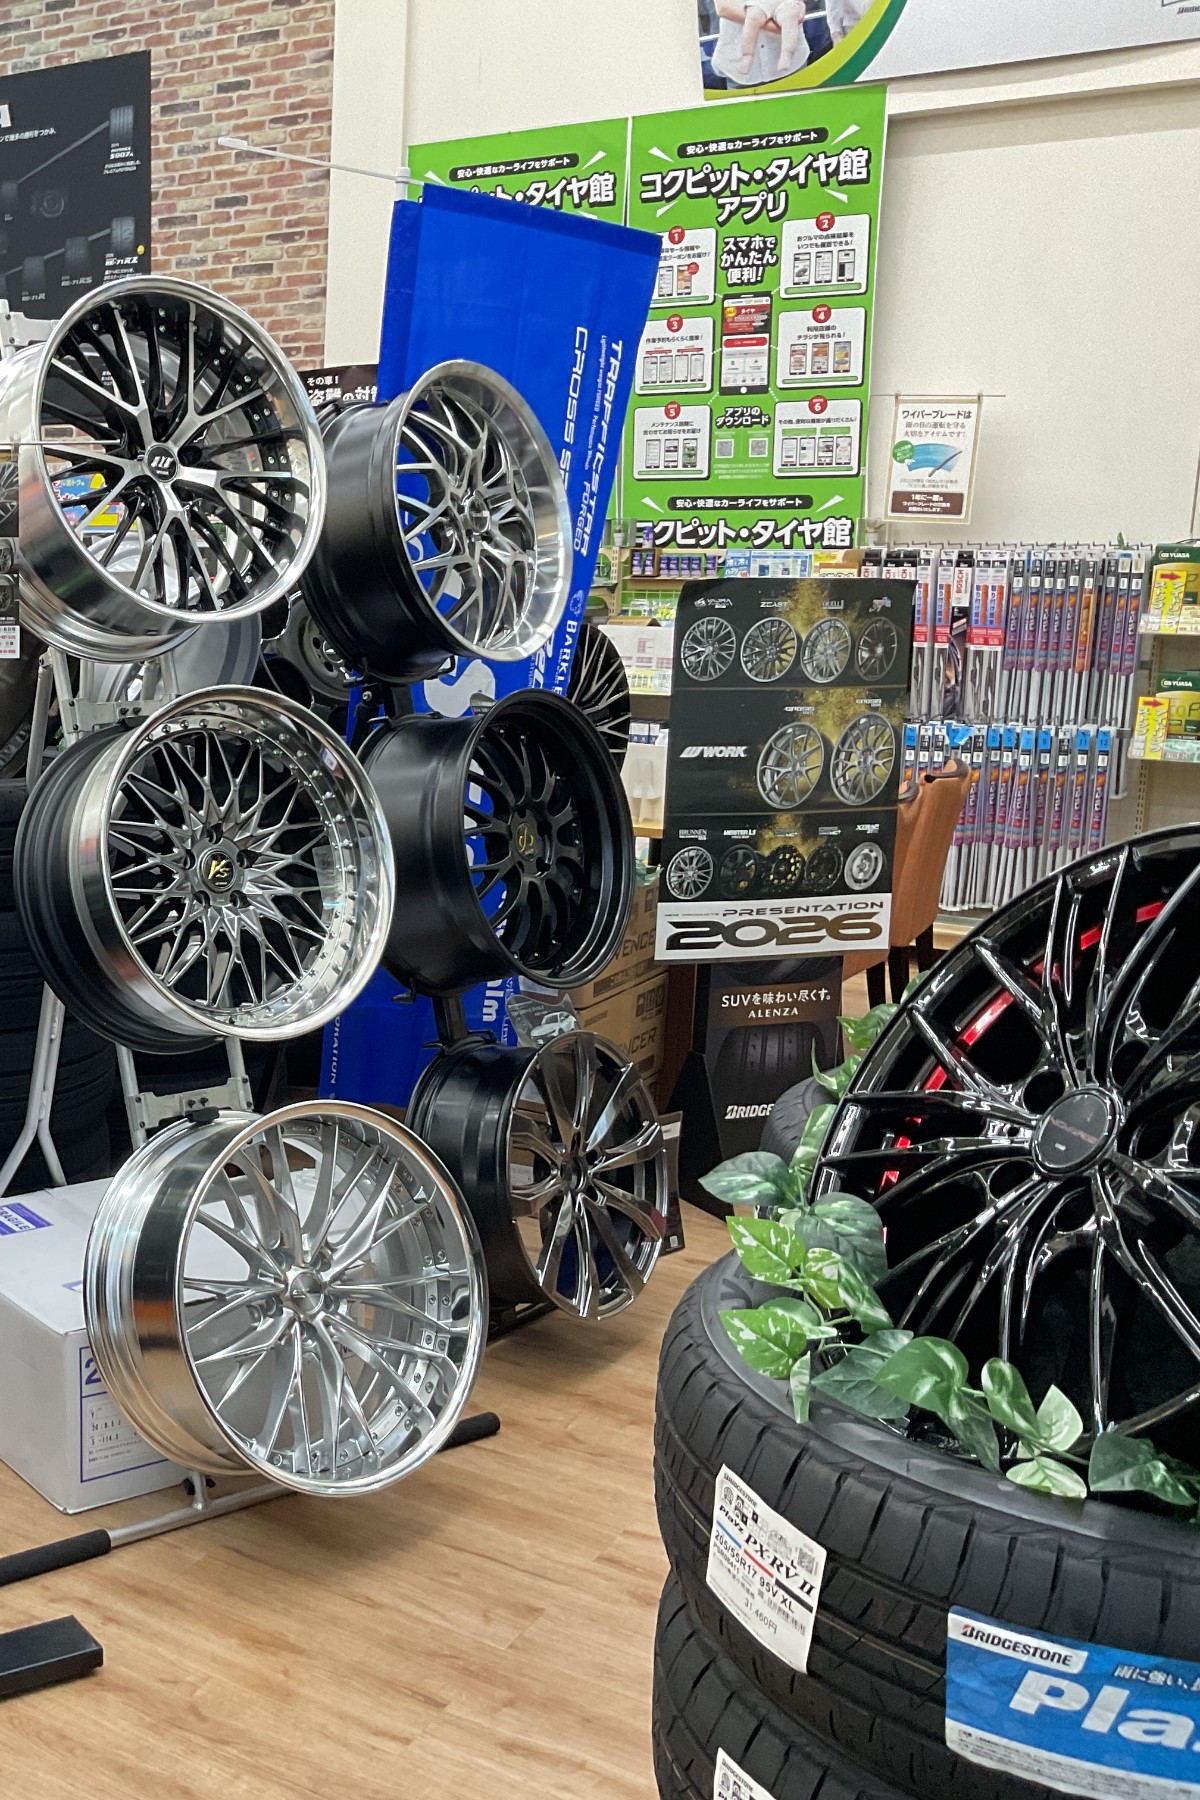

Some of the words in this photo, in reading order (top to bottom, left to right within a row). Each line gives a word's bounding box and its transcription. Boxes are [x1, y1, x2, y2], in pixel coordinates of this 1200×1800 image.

[686, 131, 818, 155] 安心・快適なカーライフをサポート
[456, 157, 571, 179] 安心・快適なカーライフをサポート
[641, 148, 870, 200] コクピット・タイヤ館
[717, 191, 787, 223] アプリ
[821, 219, 829, 228] 2
[723, 236, 776, 250] スマホで
[720, 251, 777, 268] かんたん
[726, 268, 763, 286] 便利!
[818, 312, 825, 320] 4
[672, 321, 678, 330] 3
[307, 375, 339, 386] その車!
[563, 325, 589, 445] CROSS
[669, 408, 676, 417] 5
[725, 406, 761, 416] アプリの
[814, 402, 821, 411] 6
[902, 410, 972, 420] ワイパーブレードは
[716, 416, 770, 427] ダウンロード
[580, 339, 623, 558] TRAFFICSTAR
[675, 497, 803, 508] 安心・快適なカーライフをサポート
[573, 480, 592, 552] FORGED
[956, 569, 964, 594] BOSCH
[555, 619, 579, 696] BARKLE
[701, 746, 748, 758] WORK
[722, 901, 884, 917] PRESENTATION
[665, 911, 883, 951] 2026
[721, 988, 832, 1008] SUVを味わい尽くす。
[748, 1006, 799, 1019] ALENZA
[718, 1504, 745, 1534] Playz
[743, 1533, 799, 1580] PX-RV
[799, 1578, 816, 1598] II
[714, 1529, 758, 1579] 205/55R17
[759, 1575, 779, 1599] 95V
[780, 1595, 795, 1614] XL
[960, 1623, 1074, 1667] BRIDGESTONE
[1009, 1669, 1200, 1753] Pla
